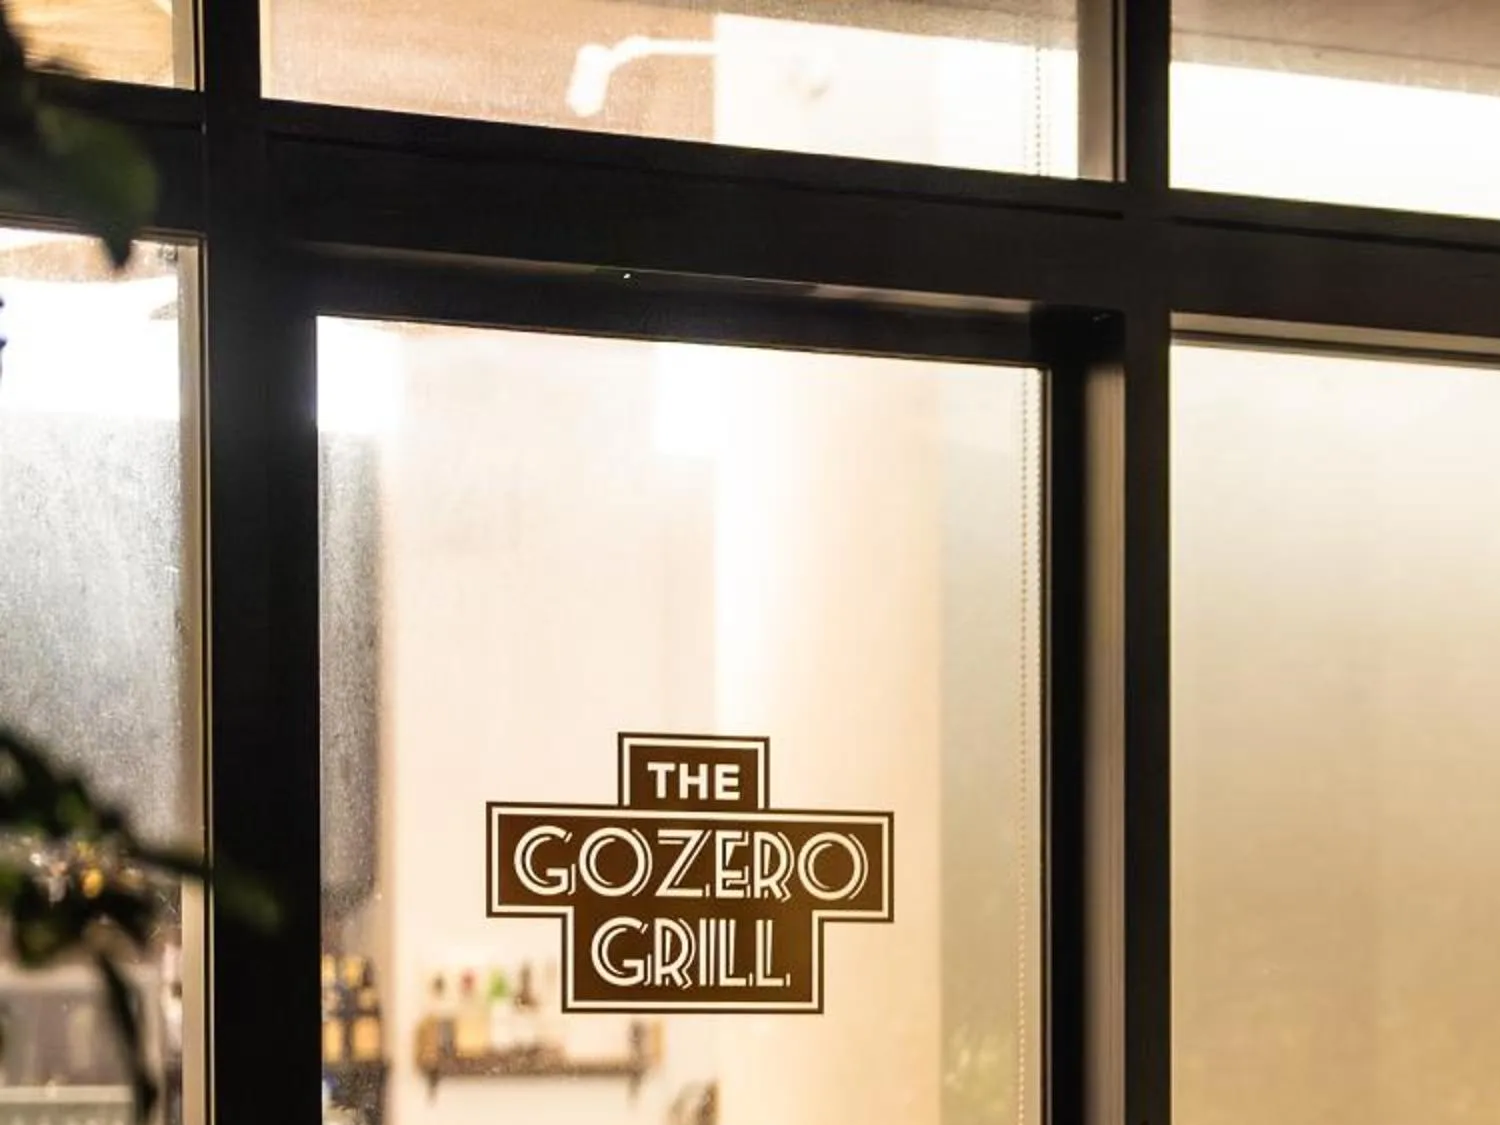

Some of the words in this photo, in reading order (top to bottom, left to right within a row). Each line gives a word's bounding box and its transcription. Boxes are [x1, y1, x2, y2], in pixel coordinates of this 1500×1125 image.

[647, 762, 741, 800] THE
[513, 825, 869, 902] GOZERO
[591, 916, 792, 989] GRILL
